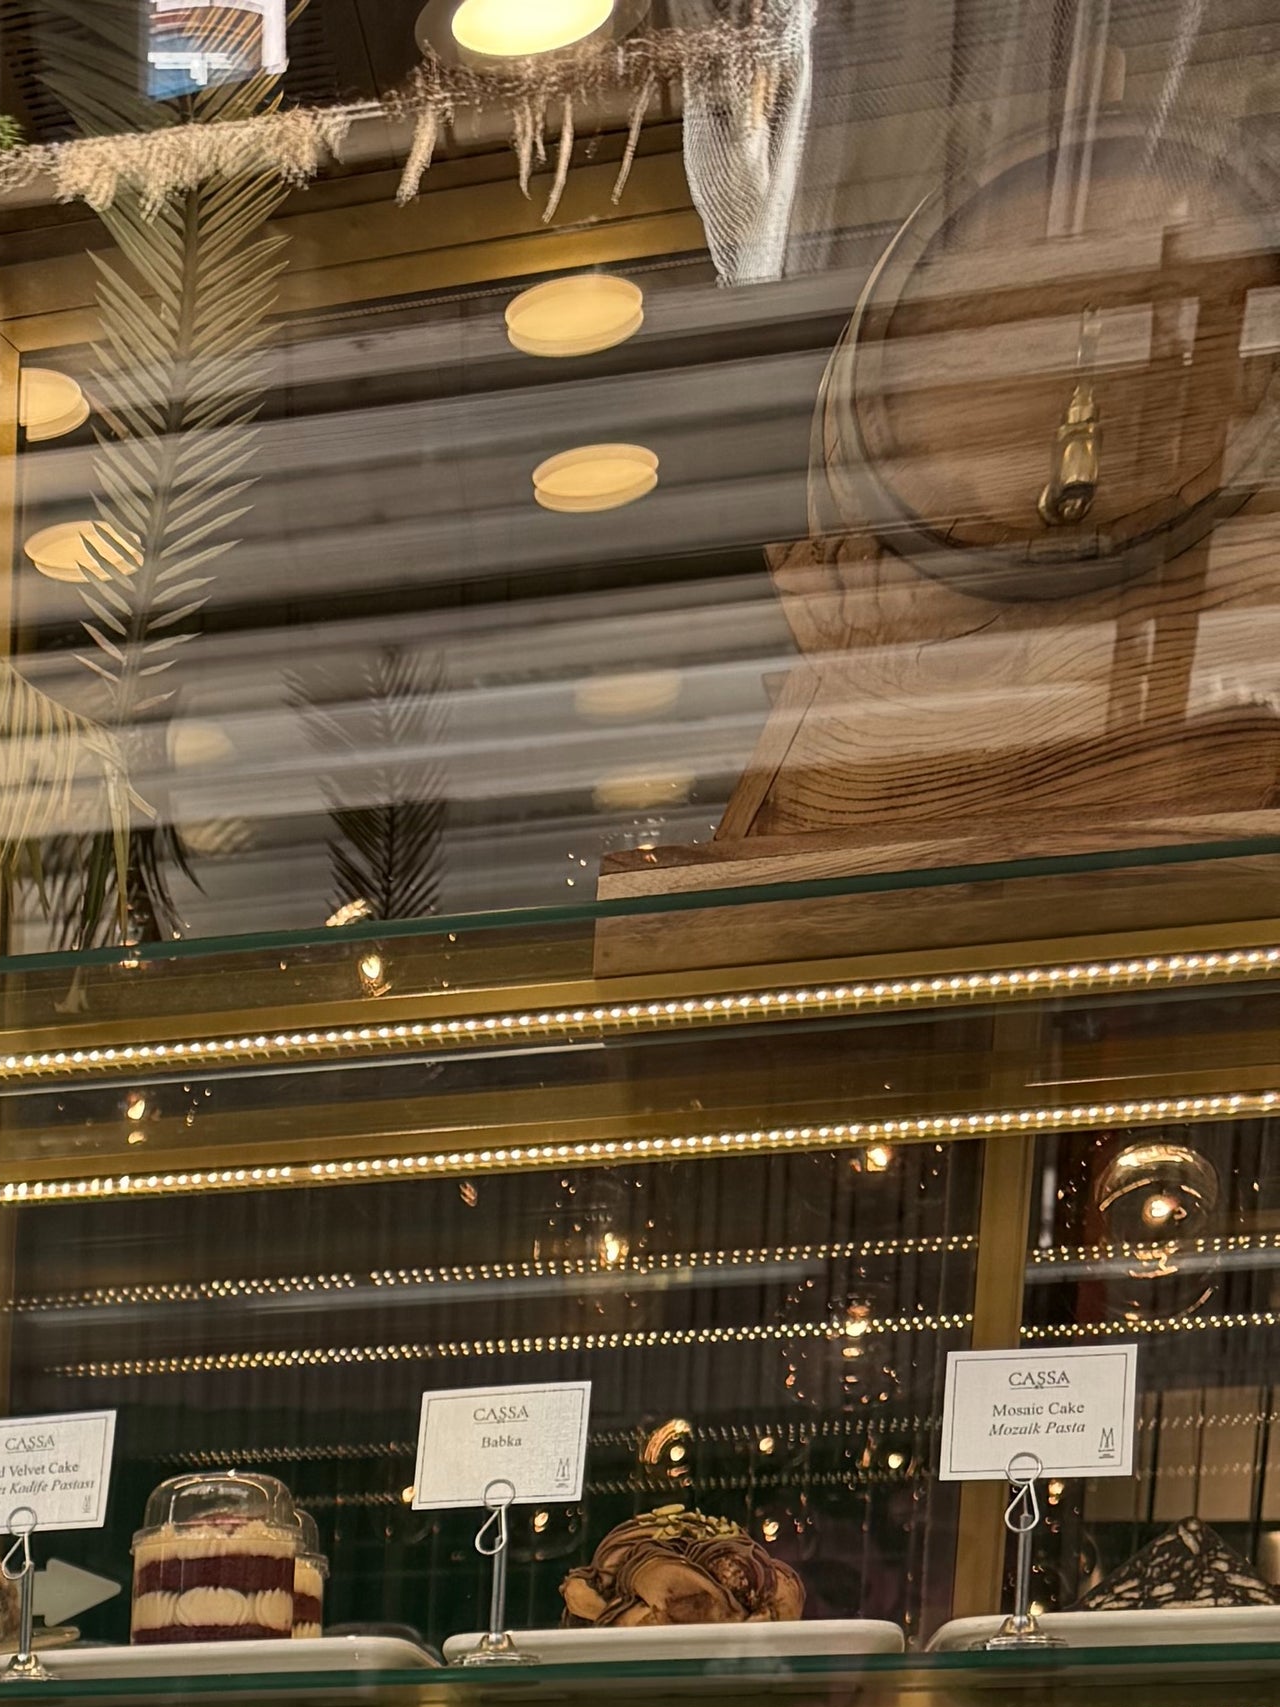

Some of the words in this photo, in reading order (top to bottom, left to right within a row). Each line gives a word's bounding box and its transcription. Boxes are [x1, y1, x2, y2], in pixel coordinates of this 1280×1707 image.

[1008, 1370, 1070, 1389] CASSA
[473, 1405, 529, 1423] CASSA
[992, 1403, 1044, 1417] Mosaic
[1048, 1402, 1085, 1415] Cake
[989, 1422, 1041, 1436] Mozaik
[1045, 1421, 1085, 1435] Pasta
[5, 1435, 55, 1453] CASSA
[481, 1435, 522, 1449] Babka
[9, 1463, 45, 1477] Velvet
[48, 1460, 80, 1474] Cake
[9, 1480, 48, 1495] Kadife
